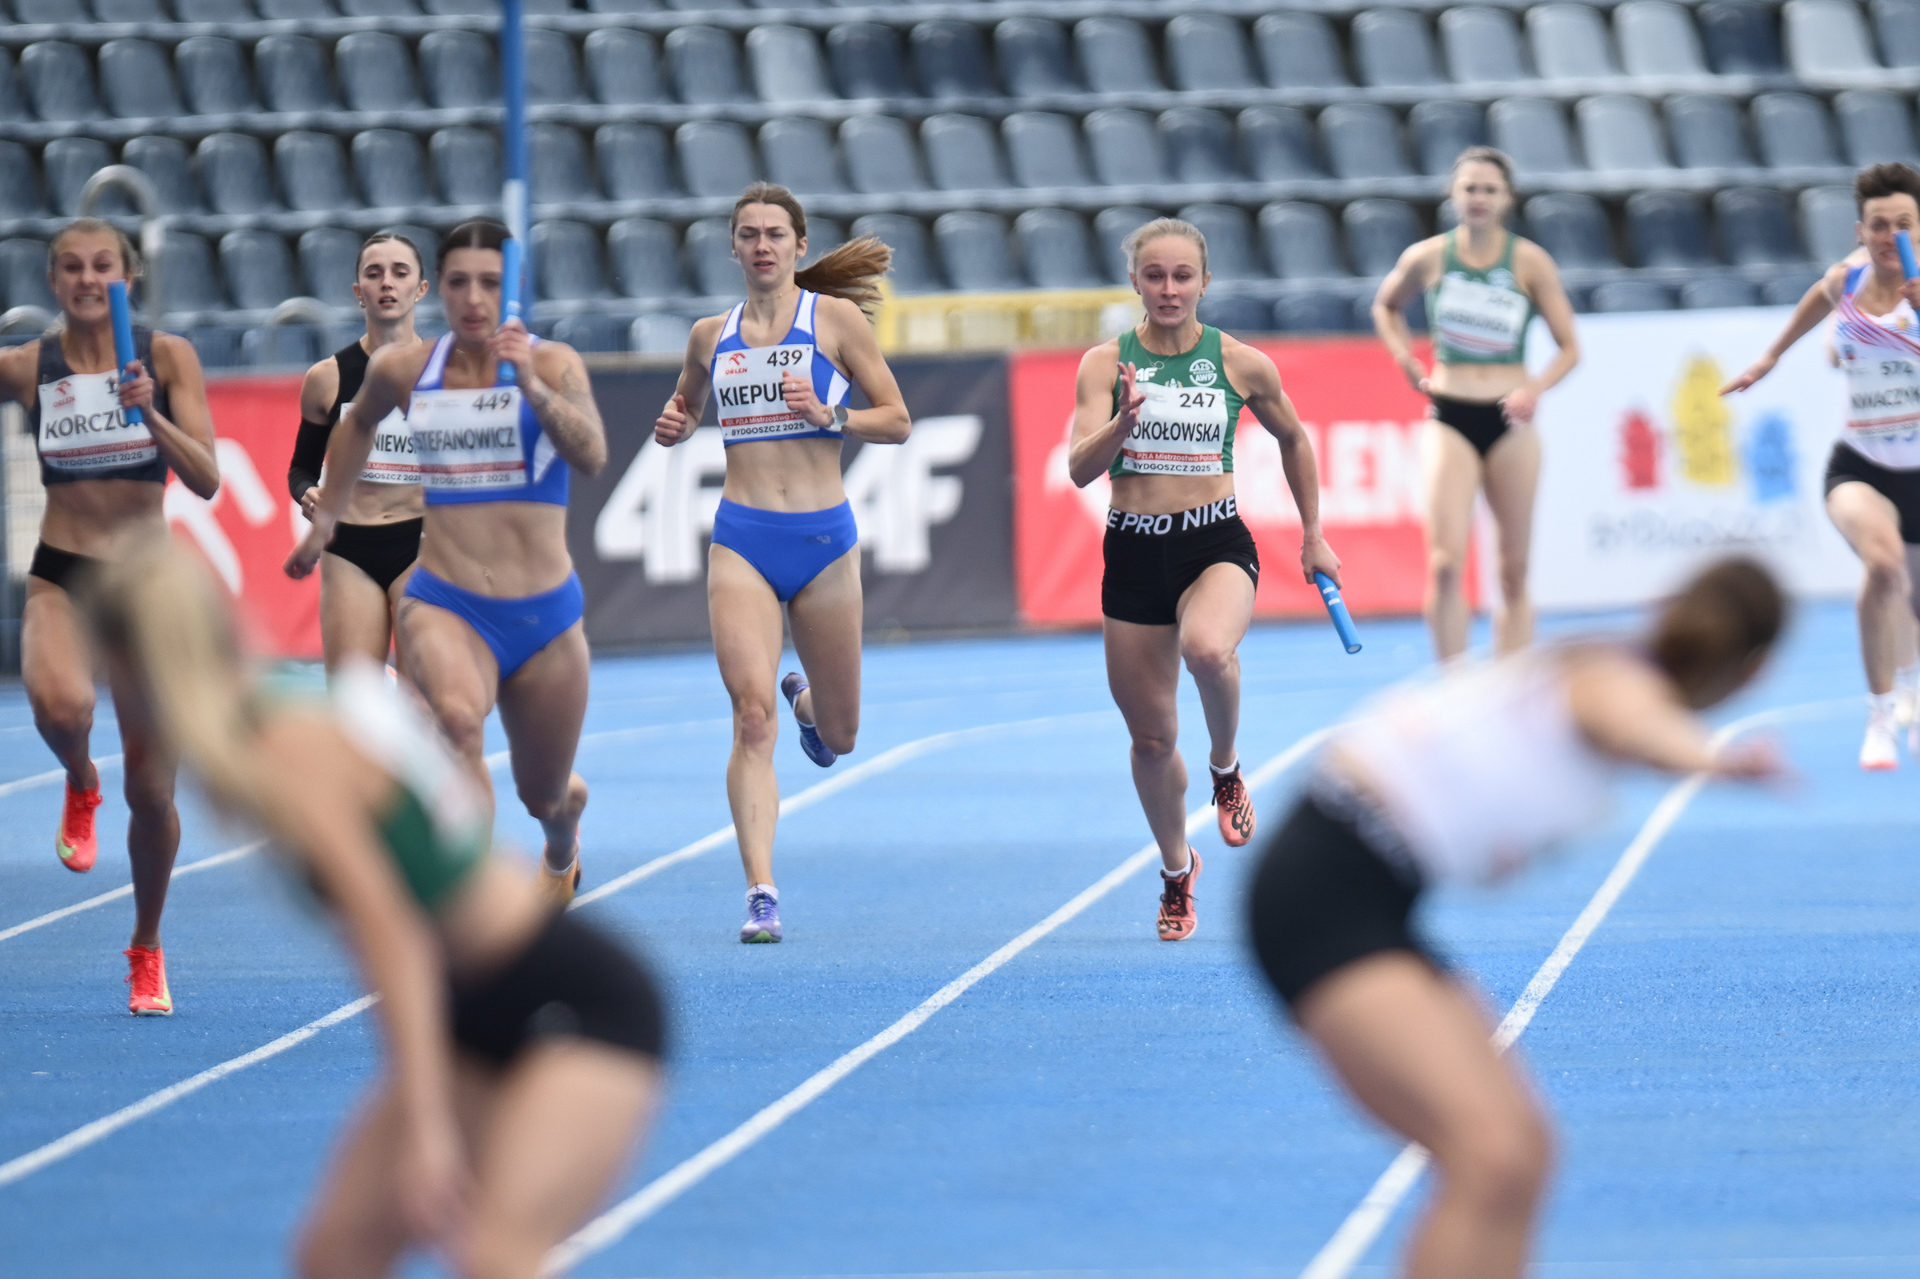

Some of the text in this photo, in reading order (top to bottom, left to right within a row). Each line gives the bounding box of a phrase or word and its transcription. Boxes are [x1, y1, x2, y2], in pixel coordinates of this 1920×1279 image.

[767, 349, 803, 367] 439
[724, 367, 748, 375] ORLEN
[472, 391, 512, 411] 449
[1179, 392, 1216, 408] 247
[45, 407, 139, 439] KORCZU
[731, 424, 781, 436] BYDGOSZCZ
[1127, 421, 1220, 442] OKOŁOWSKA
[374, 433, 417, 454] NIEWS
[414, 427, 516, 451] STEFANOWICZ
[1155, 453, 1199, 462] Mistrzostwa
[1190, 464, 1211, 472] 2025
[1234, 418, 1428, 524] RLEN
[1120, 512, 1172, 535] PRO
[1182, 494, 1236, 531] NIKE
